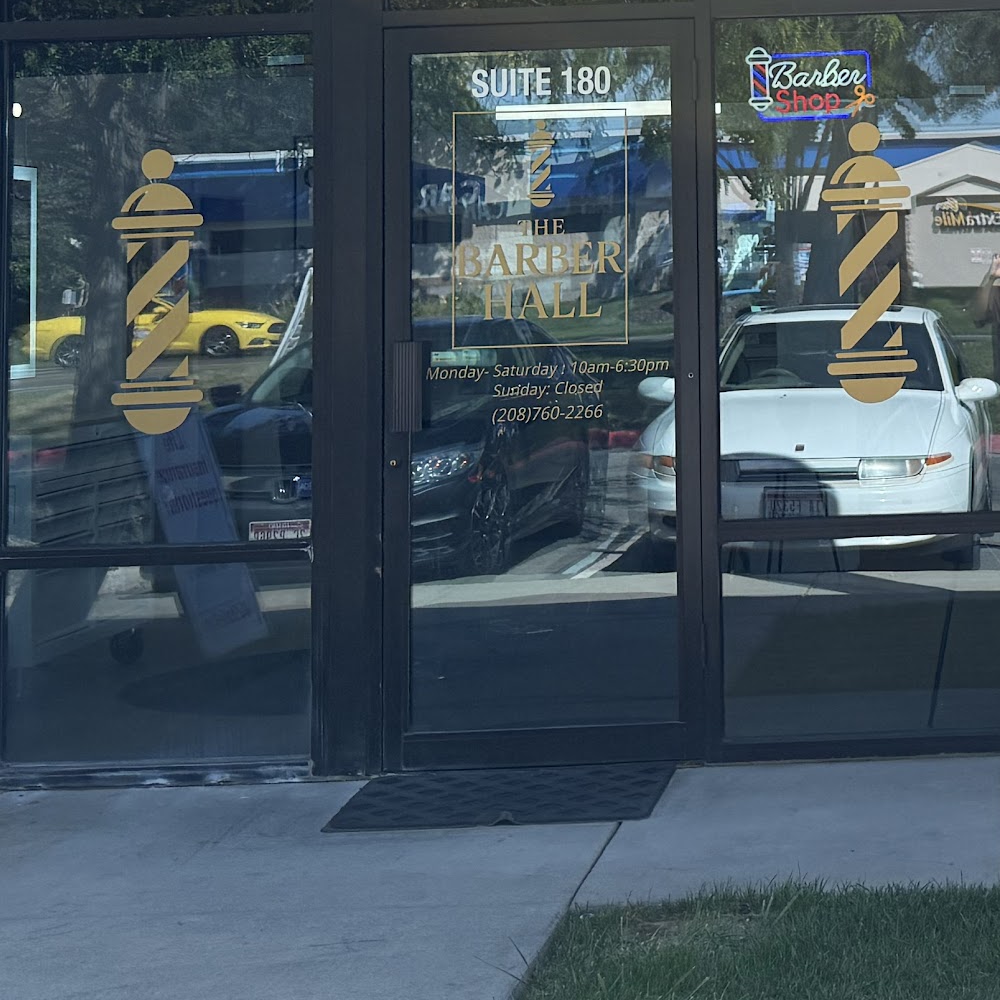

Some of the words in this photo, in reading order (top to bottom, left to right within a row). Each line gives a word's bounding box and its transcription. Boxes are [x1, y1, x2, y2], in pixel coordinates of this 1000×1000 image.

[471, 68, 551, 98] SUITE
[561, 65, 611, 95] 180
[769, 58, 867, 89] Barber
[775, 89, 841, 113] Shop
[517, 218, 566, 236] THE
[456, 240, 624, 278] BARBER
[483, 280, 603, 321] HALL
[426, 366, 489, 382] Monday-
[493, 362, 558, 380] Saturday
[571, 358, 670, 376] 10am-6:30pm
[492, 381, 551, 399] Sunday:
[555, 379, 604, 396] Closed
[491, 404, 604, 424] (208)760-2266
